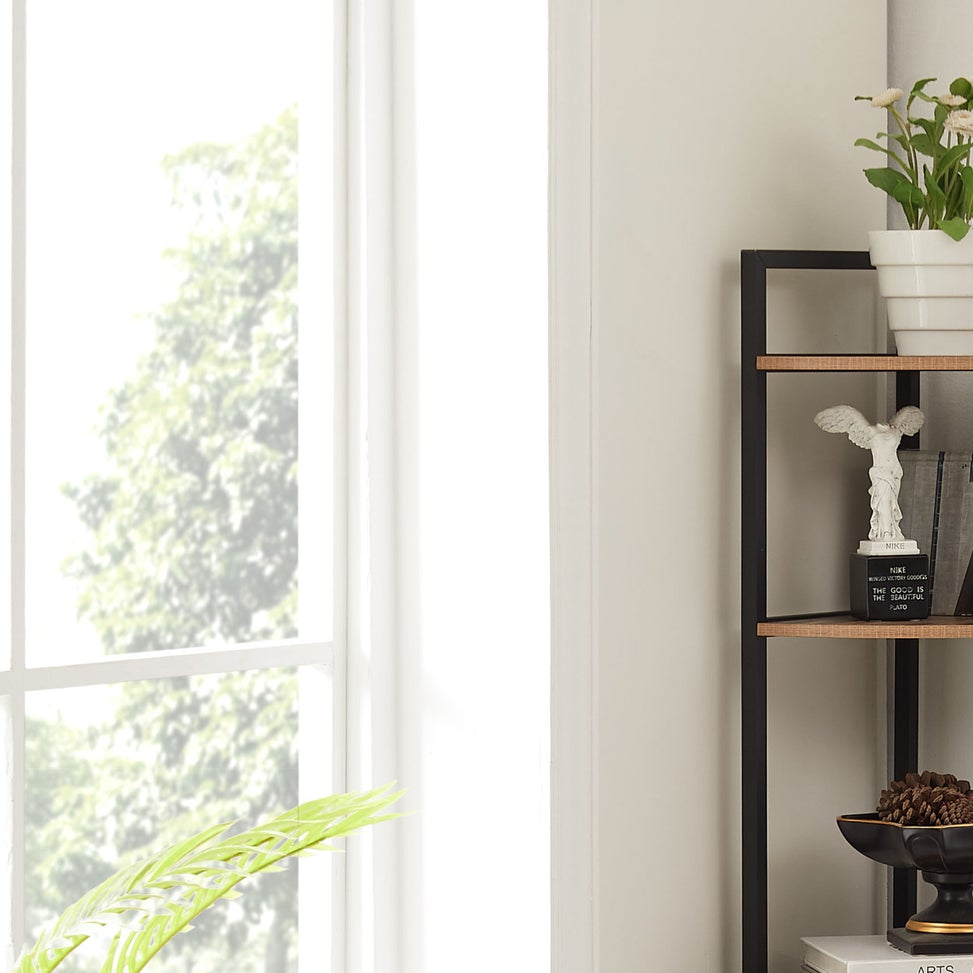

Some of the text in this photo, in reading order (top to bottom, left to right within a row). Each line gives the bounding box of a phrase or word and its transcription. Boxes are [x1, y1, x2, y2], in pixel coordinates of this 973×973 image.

[889, 566, 907, 574] NIKE
[890, 586, 913, 594] GOOD
[916, 585, 924, 593] IS
